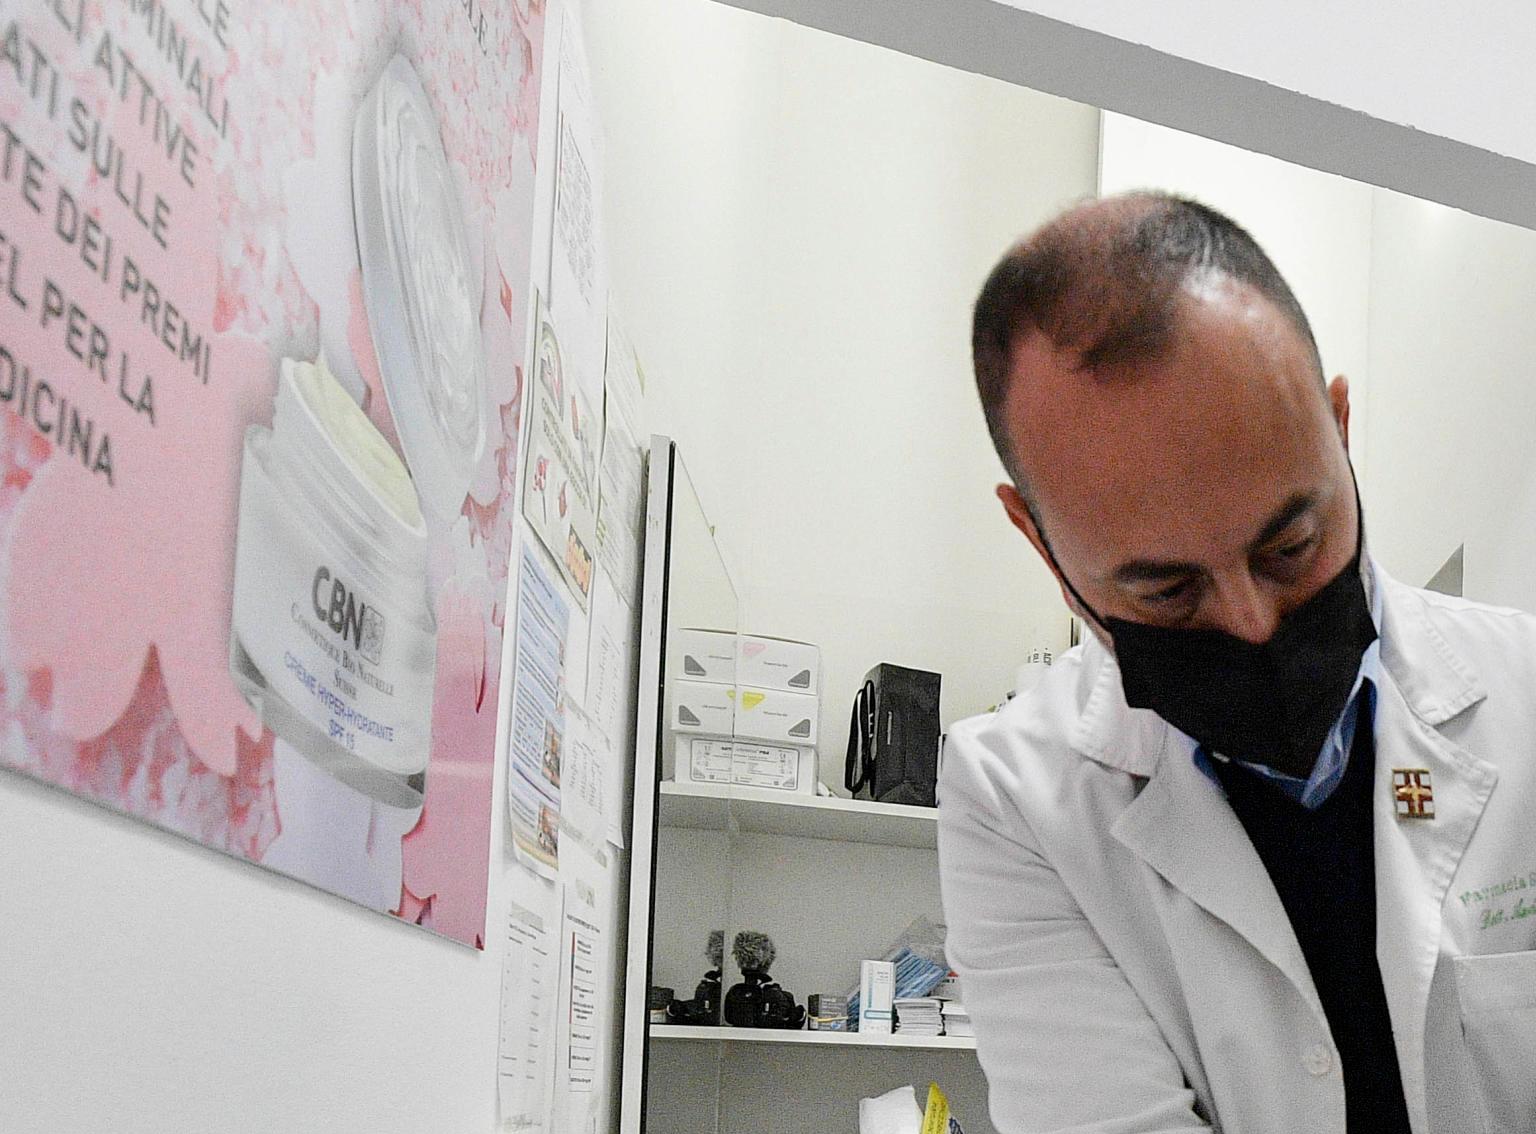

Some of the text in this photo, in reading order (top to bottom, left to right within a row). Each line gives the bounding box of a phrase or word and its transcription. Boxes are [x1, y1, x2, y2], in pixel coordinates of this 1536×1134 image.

[67, 97, 171, 249] SULLE
[94, 29, 199, 188] ATTIVE
[0, 119, 211, 386] TE DEI PREMI
[0, 229, 156, 428] L PER LA
[0, 345, 115, 488] DICINA
[311, 565, 367, 651] CBN
